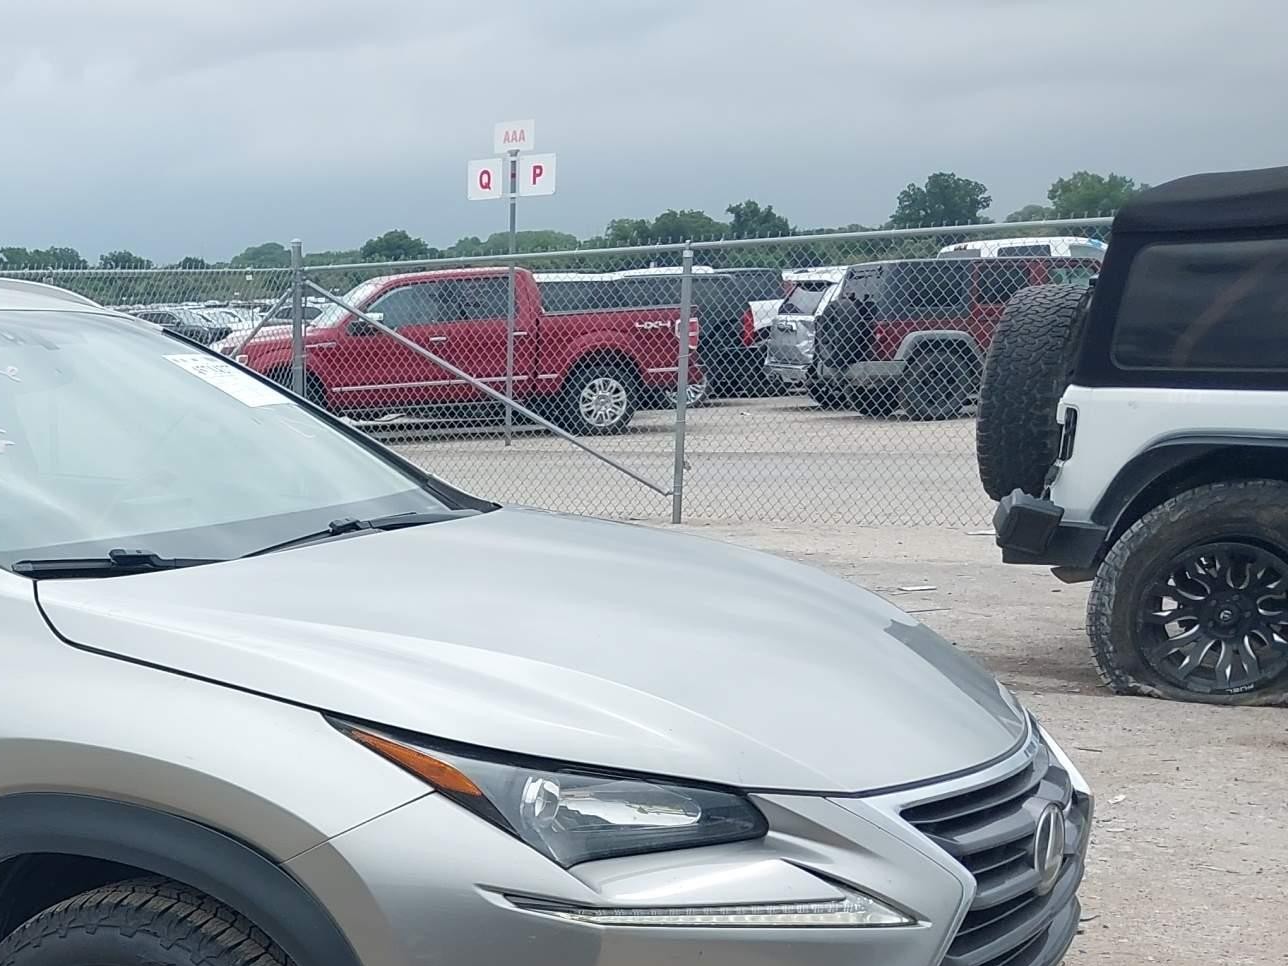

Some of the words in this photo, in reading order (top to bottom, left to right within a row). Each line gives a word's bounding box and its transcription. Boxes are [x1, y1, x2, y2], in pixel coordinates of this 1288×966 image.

[503, 128, 526, 144] AAA
[479, 169, 492, 190] Q
[532, 165, 544, 186] P
